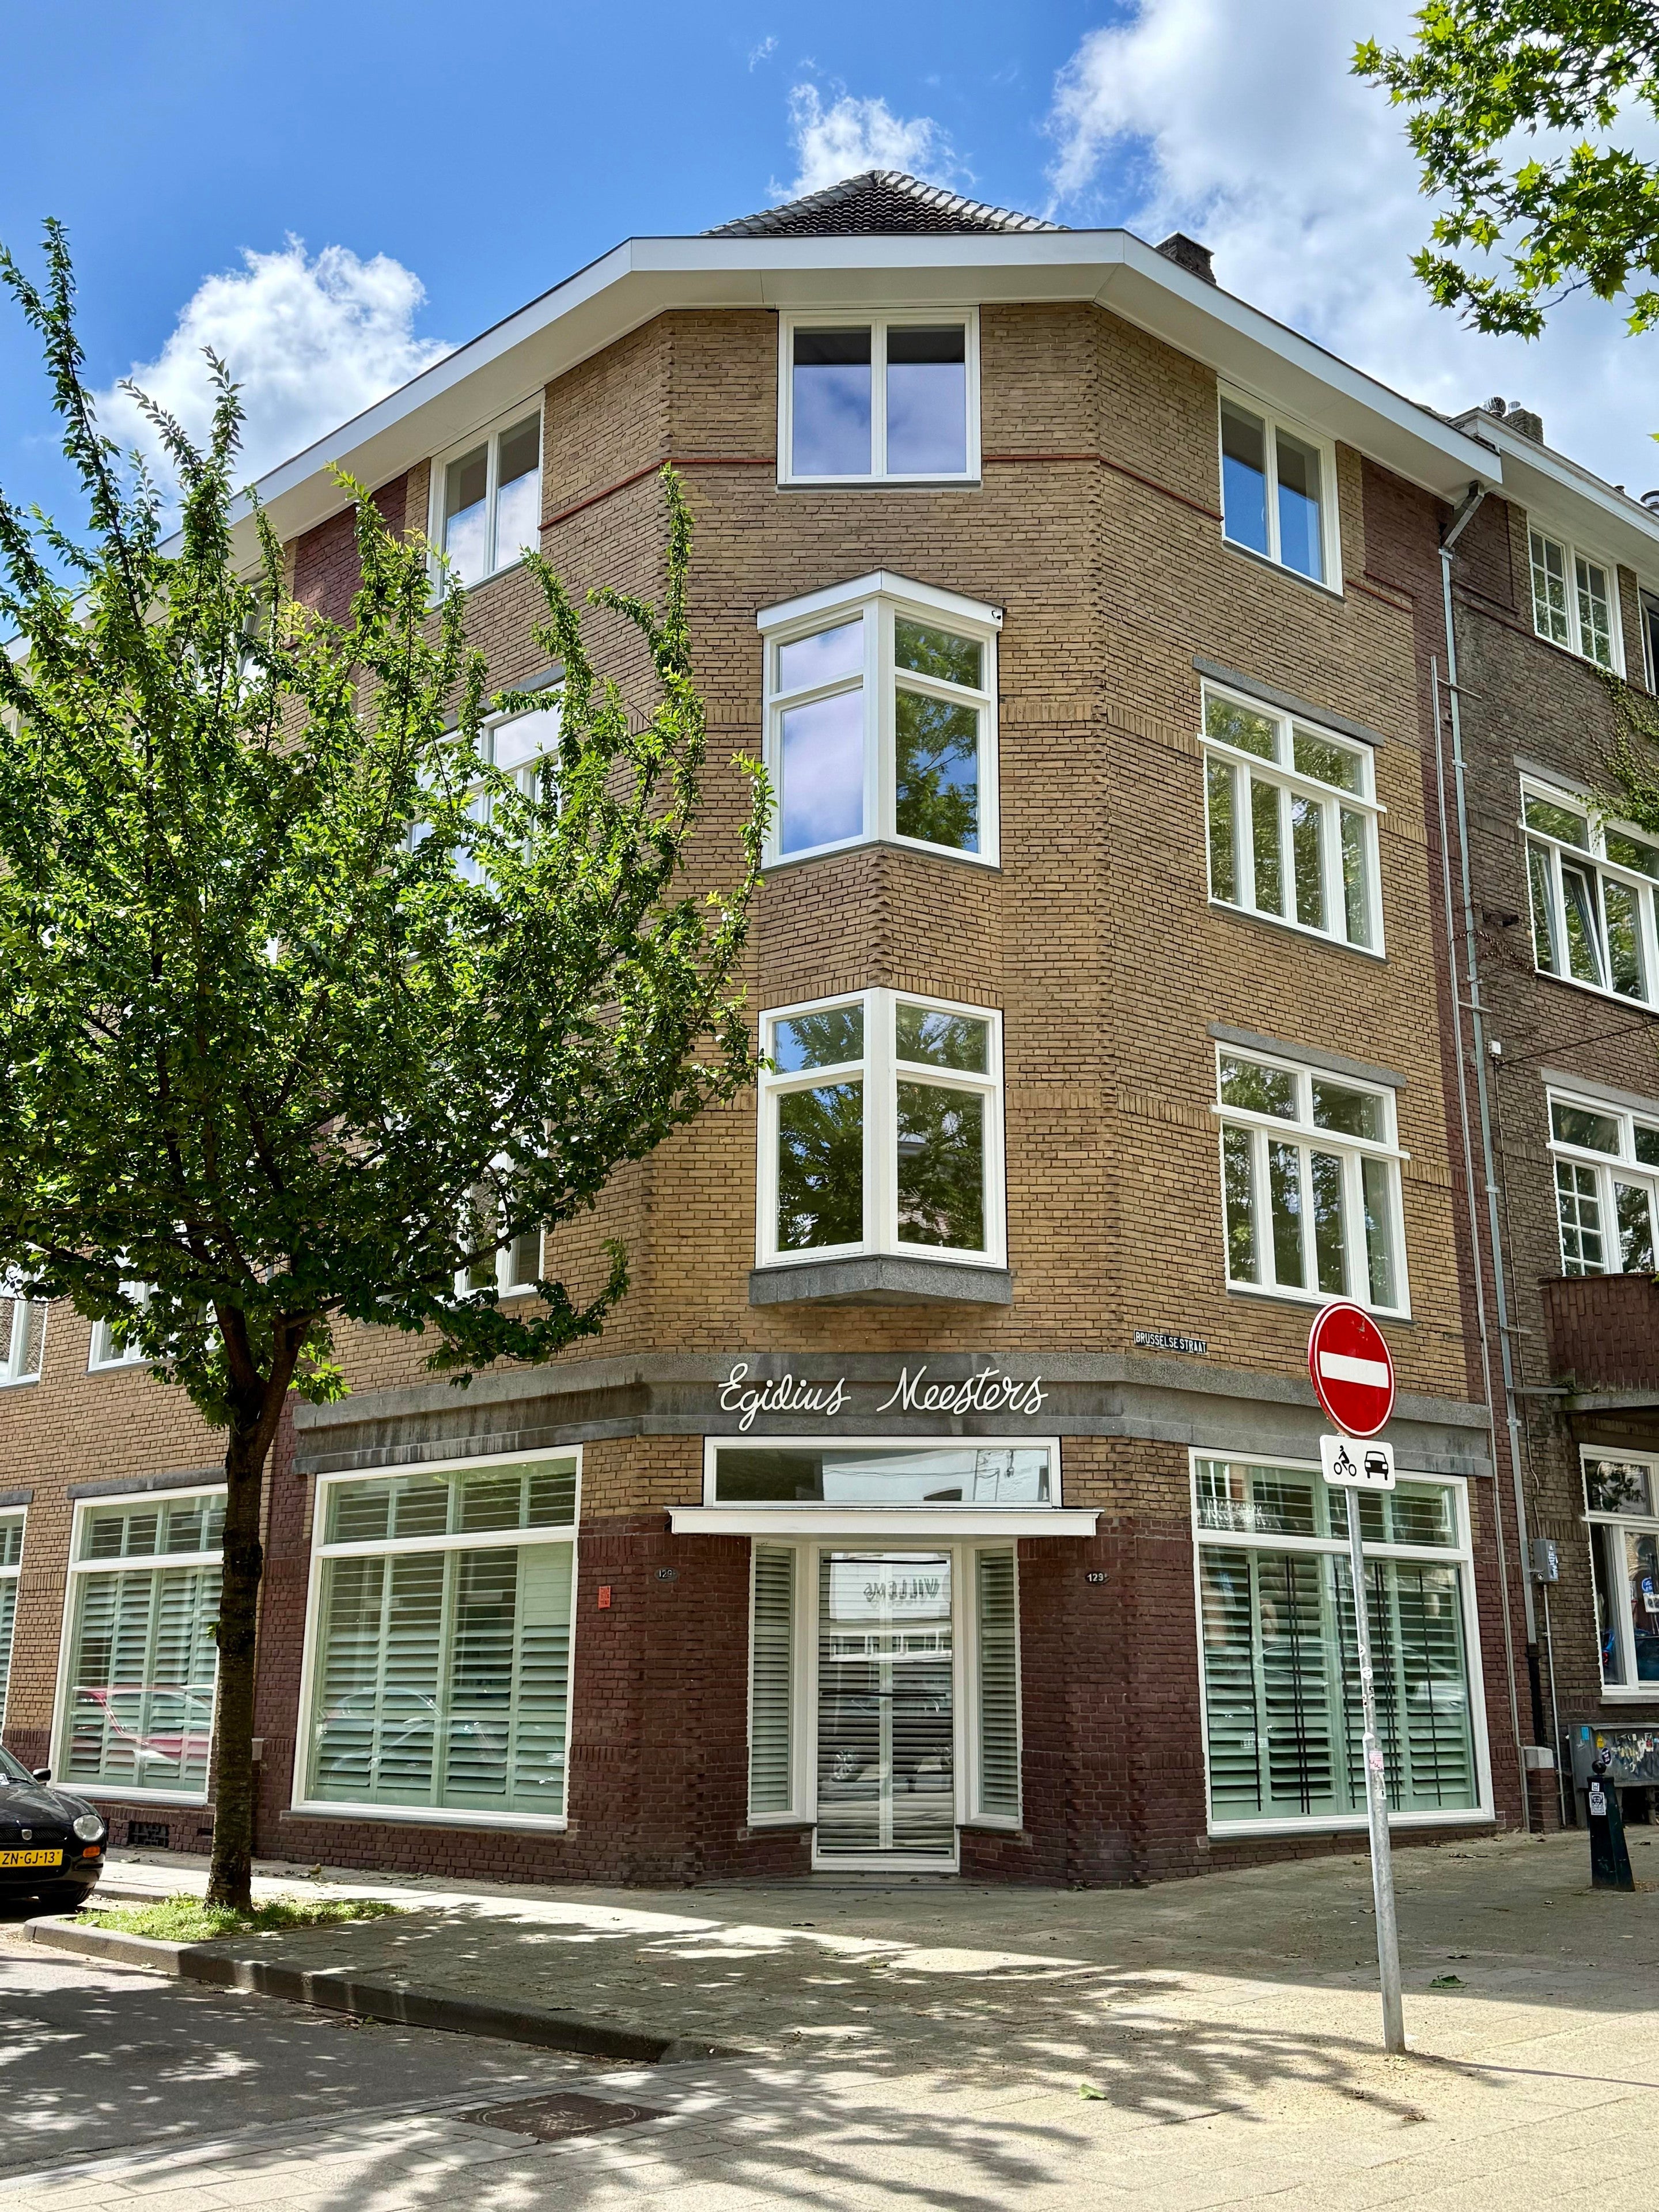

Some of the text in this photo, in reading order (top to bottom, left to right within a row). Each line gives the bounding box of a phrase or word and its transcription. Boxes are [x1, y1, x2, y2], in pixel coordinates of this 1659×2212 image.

[1135, 1331, 1206, 1353] BRUSSELSE STRAAT
[718, 1363, 1048, 1431] Egidius Meesters
[1086, 1573, 1104, 1582] 129
[2, 1851, 55, 1865] ZN-GJ-13
